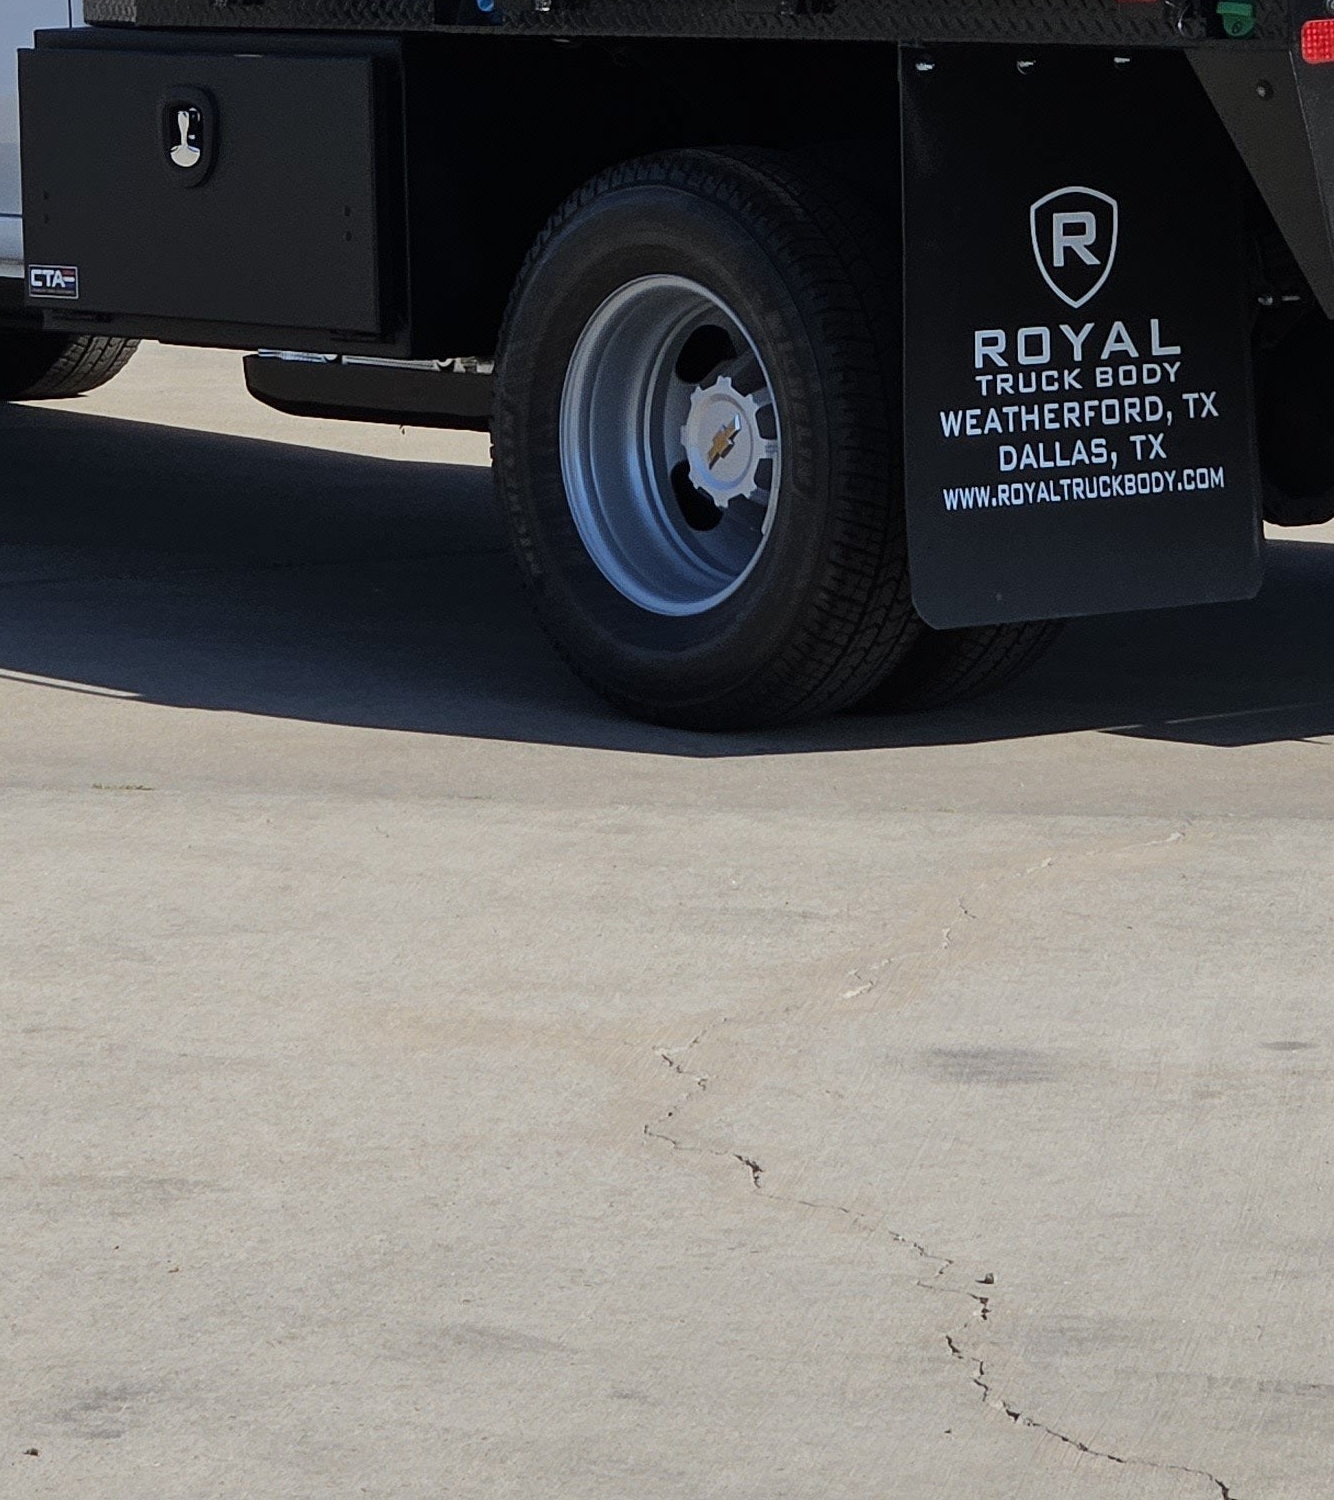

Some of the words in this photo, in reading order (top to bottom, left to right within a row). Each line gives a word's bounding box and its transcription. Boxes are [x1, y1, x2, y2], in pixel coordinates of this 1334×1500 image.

[1053, 212, 1101, 267] R
[31, 268, 66, 288] CTA
[974, 319, 1181, 368] ROYAL
[975, 368, 1083, 396] TRUCK
[1096, 362, 1181, 388] BODY
[939, 396, 1173, 438] WEATHERFORD,
[1182, 391, 1219, 418] TX
[999, 438, 1118, 472] DALLAS,
[1130, 433, 1167, 460] TX
[943, 466, 1225, 511] WWW.ROYALTRUCKBODY.COM
